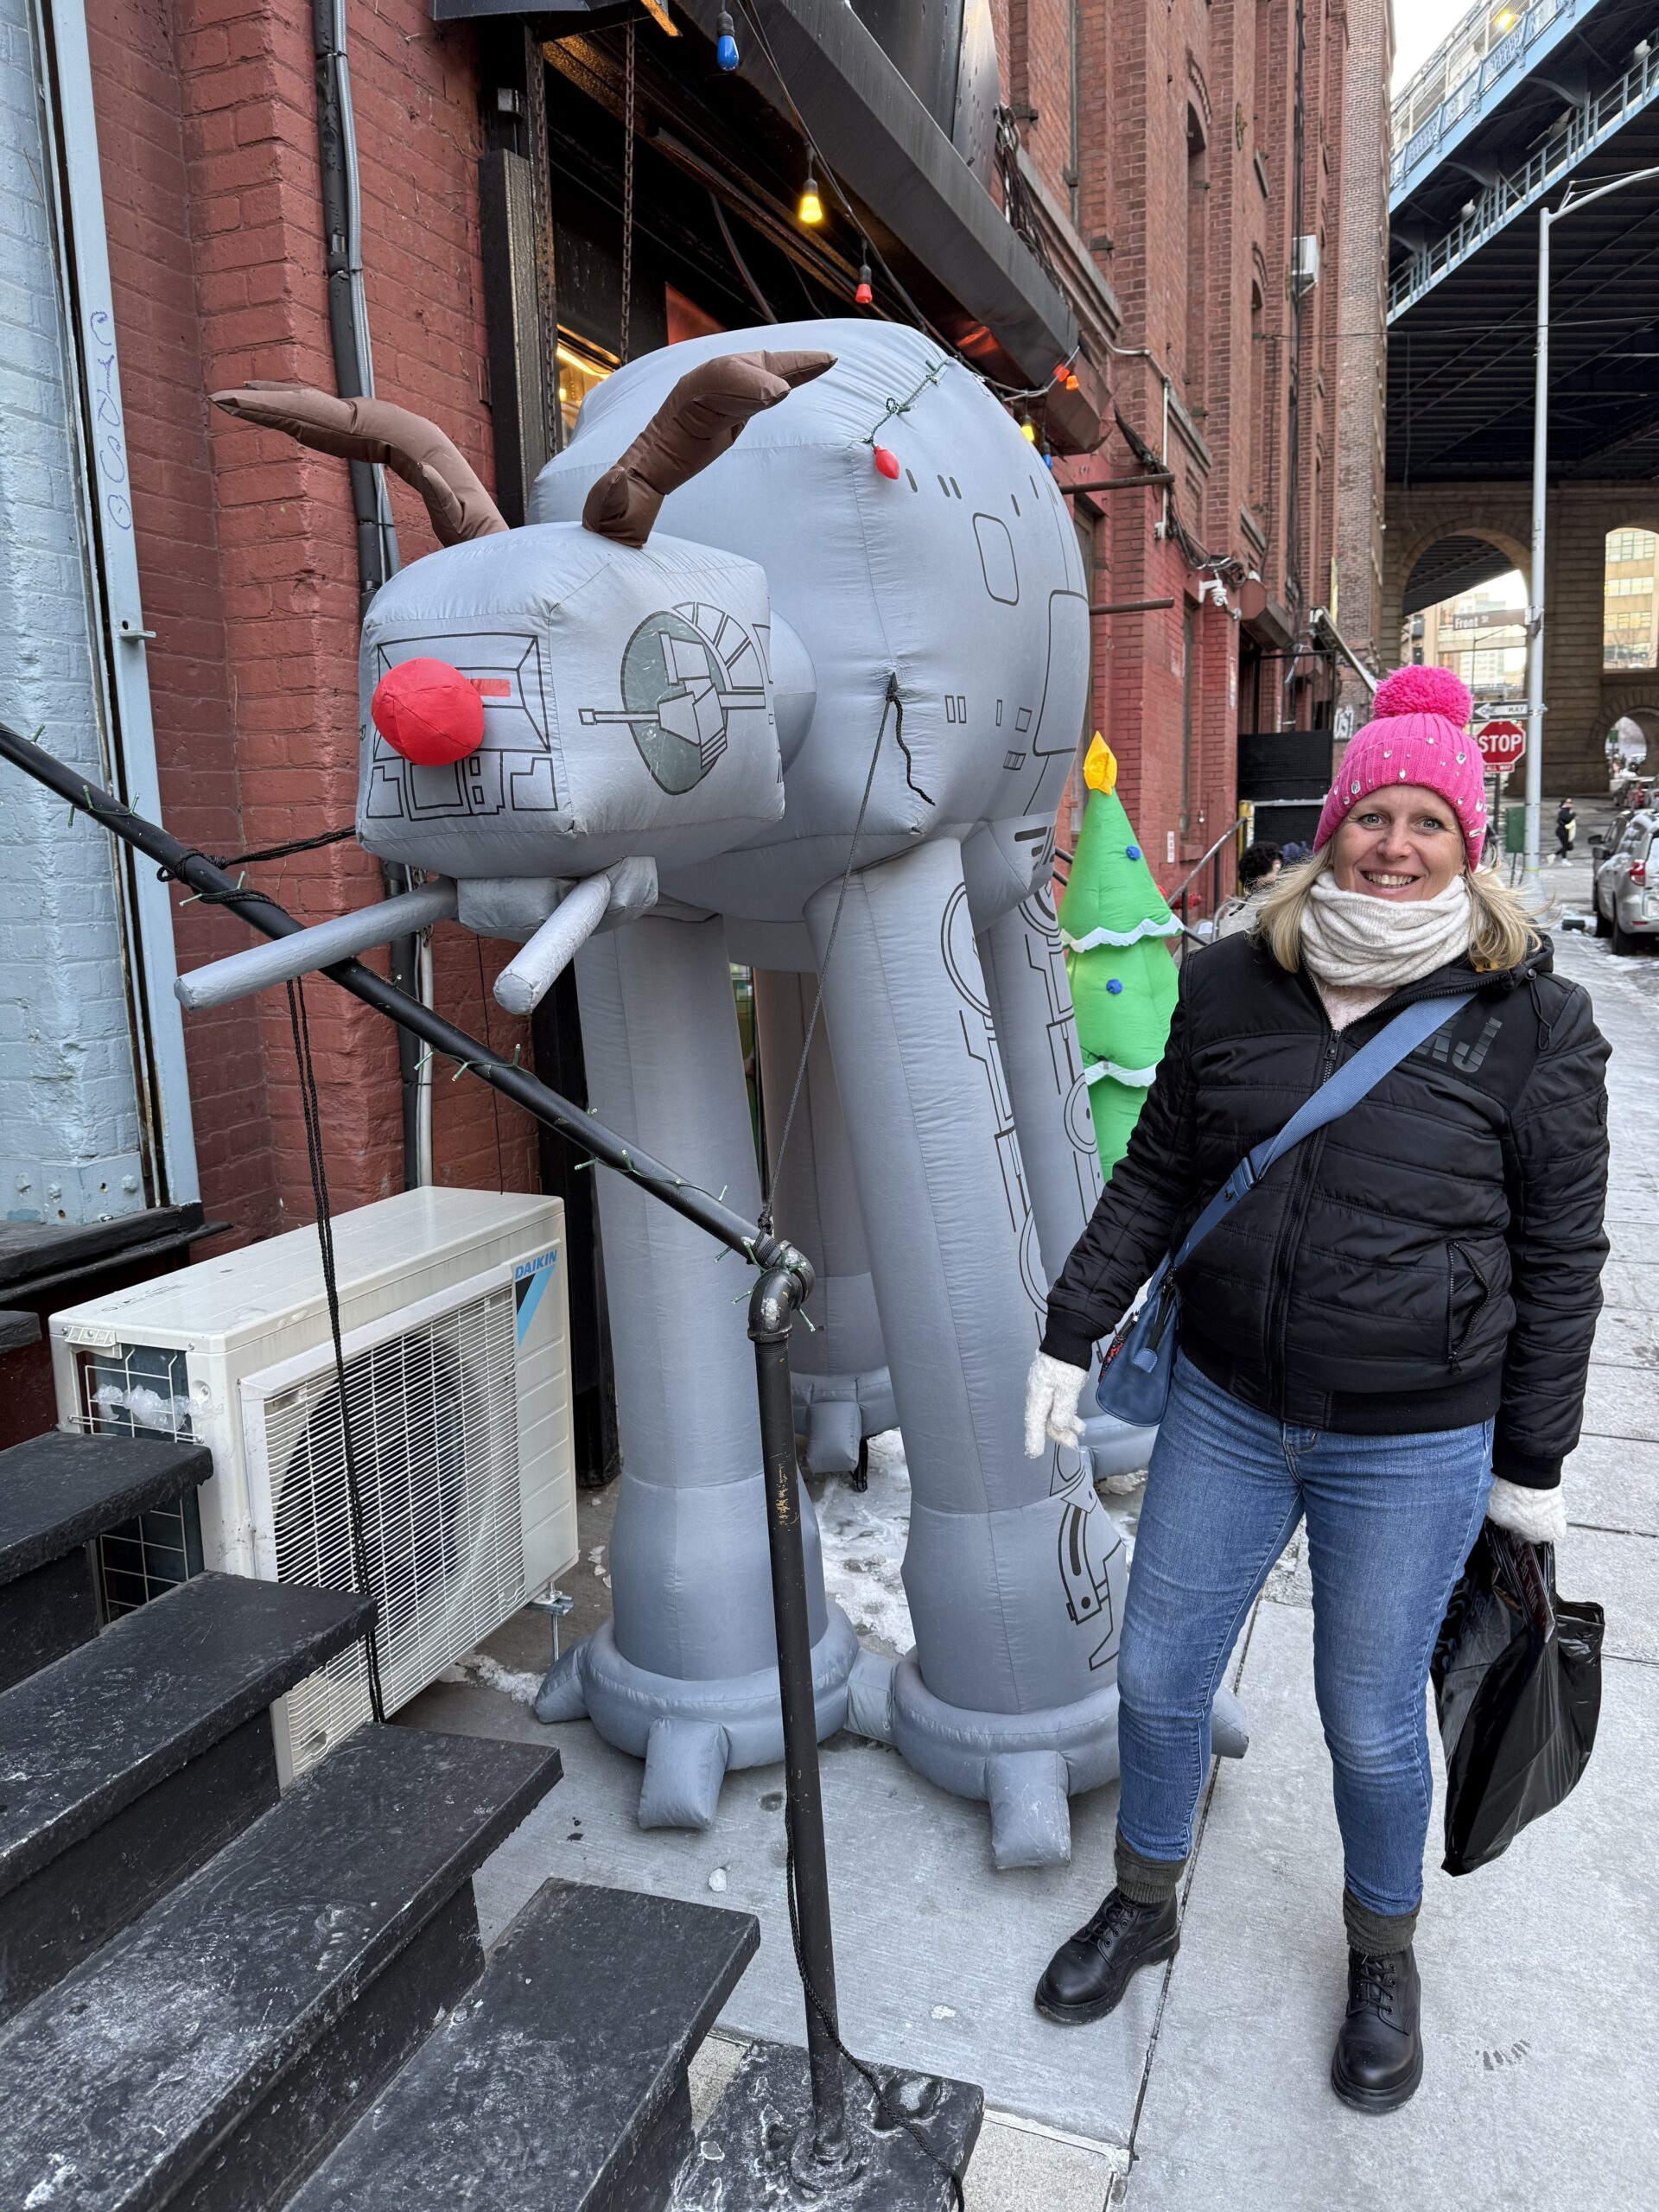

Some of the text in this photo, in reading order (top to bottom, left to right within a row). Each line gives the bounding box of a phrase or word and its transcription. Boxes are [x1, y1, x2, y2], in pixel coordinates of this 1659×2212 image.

[1455, 617, 1478, 629] Front
[1480, 706, 1496, 715] ONE
[1478, 734, 1522, 753] STOP
[514, 1249, 558, 1281] DAIKIN
